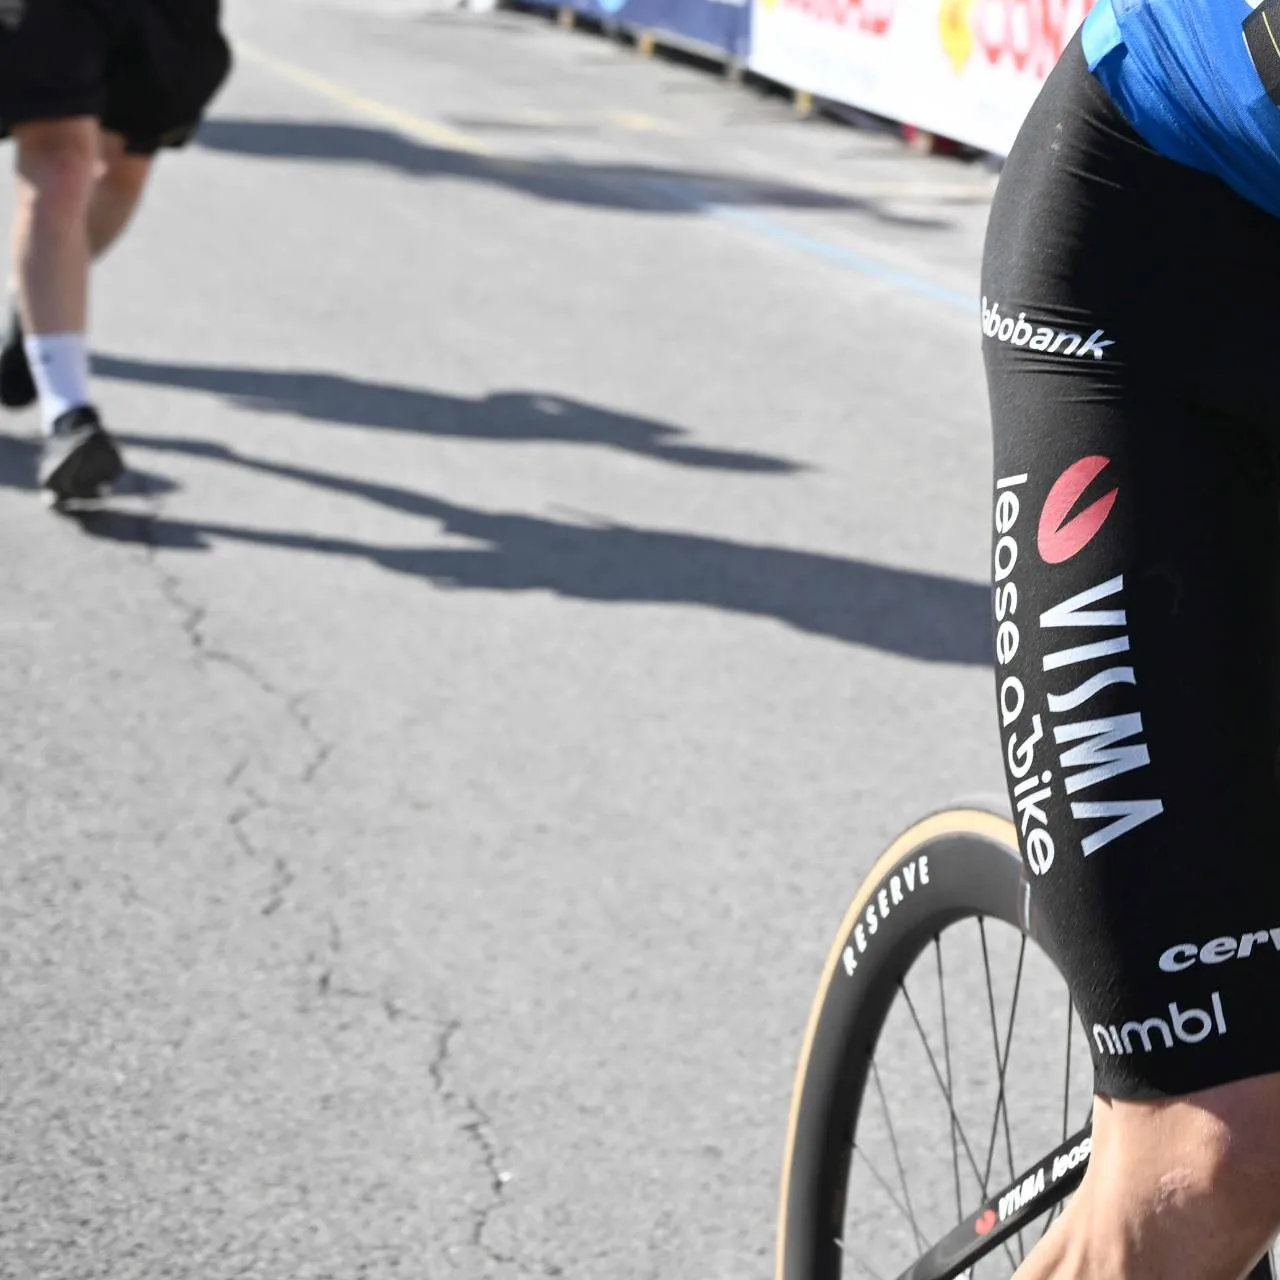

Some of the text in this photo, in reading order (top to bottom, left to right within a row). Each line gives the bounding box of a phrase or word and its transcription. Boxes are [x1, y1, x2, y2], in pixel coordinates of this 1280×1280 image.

[994, 472, 1056, 877] lease a bike
[1039, 573, 1165, 858] VISMA
[842, 855, 930, 977] RESERVE
[1092, 990, 1228, 1056] nimbl
